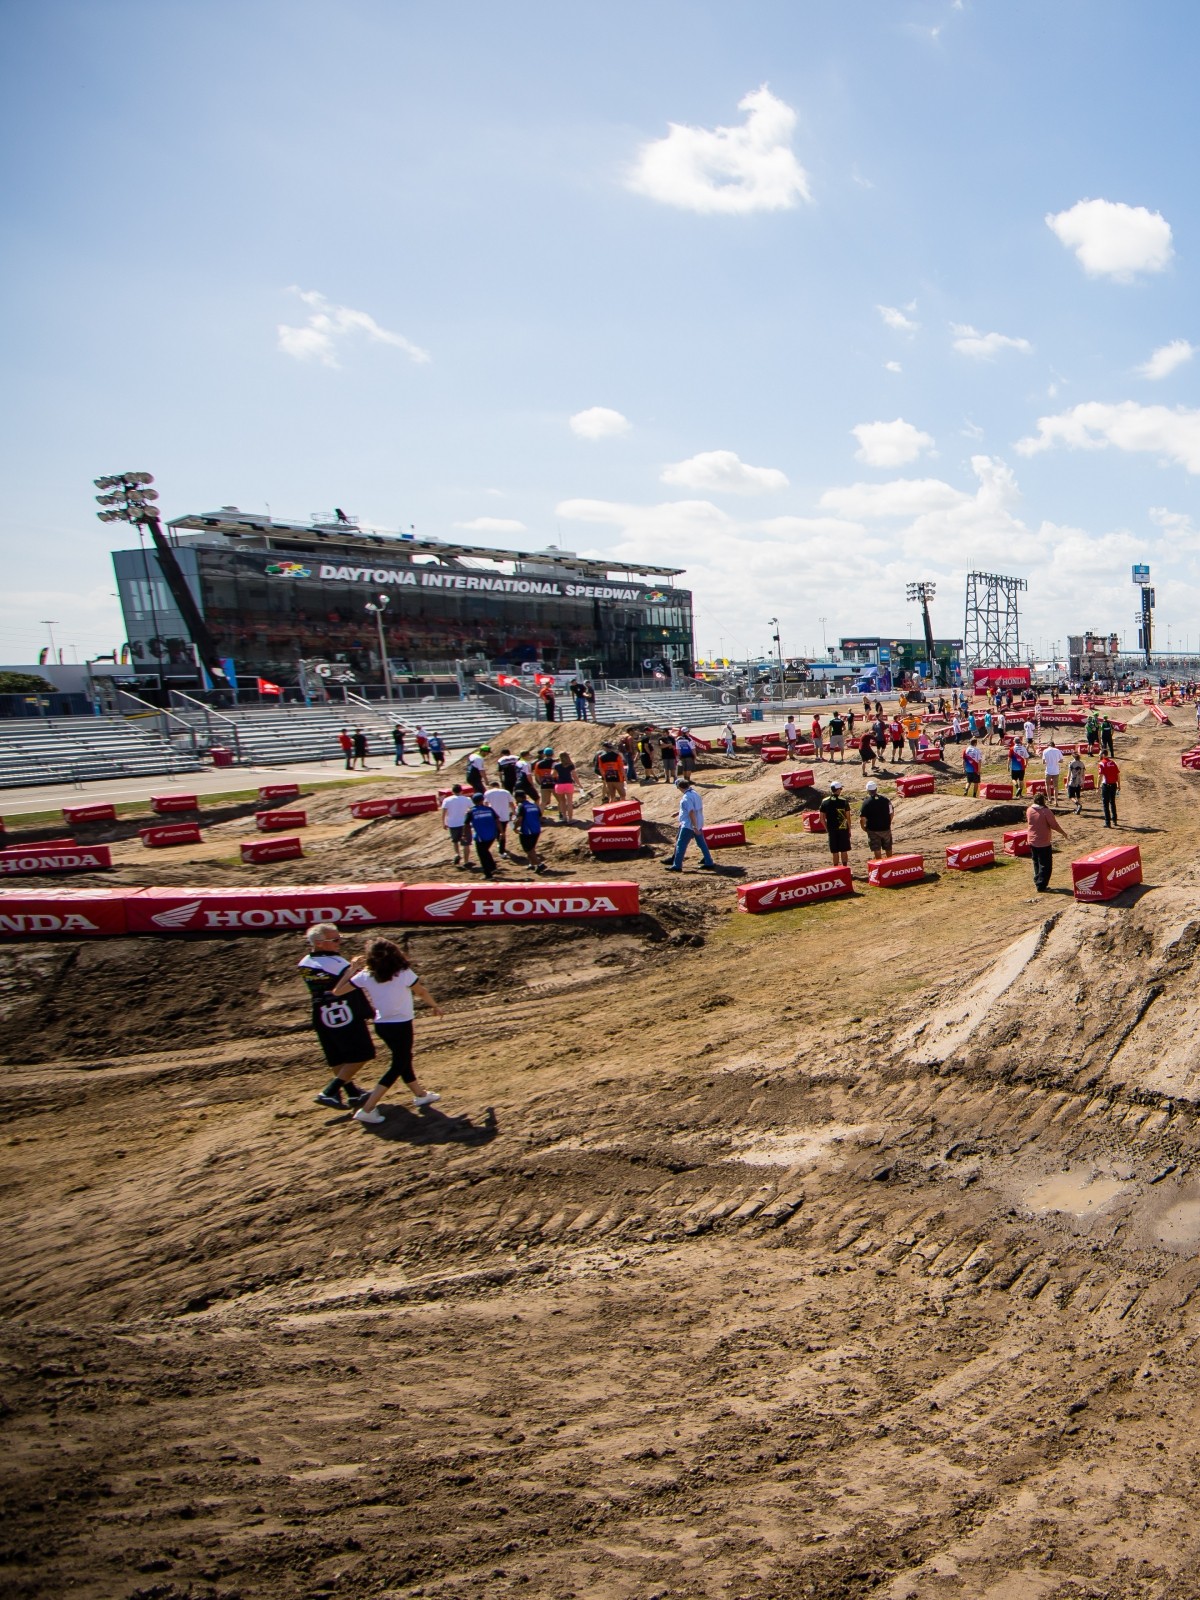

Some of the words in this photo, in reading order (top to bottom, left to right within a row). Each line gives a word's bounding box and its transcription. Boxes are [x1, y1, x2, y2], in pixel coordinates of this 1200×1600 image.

[319, 564, 417, 586] DAYTONA
[421, 573, 562, 596] INTERNATIONAL
[565, 584, 641, 601] SPEEDWAY
[315, 663, 332, 678] G
[1002, 677, 1027, 686] HONDA
[912, 782, 933, 790] HONDA
[615, 808, 641, 820] HONDA
[714, 831, 742, 839] HONDA
[0, 854, 101, 872] HONDA
[968, 849, 994, 861] HONDA
[892, 866, 923, 877] HONDA
[1115, 861, 1141, 878] HONDA
[779, 878, 847, 902] HONDA
[472, 896, 619, 916] HONDA
[0, 913, 100, 931] NDA
[203, 904, 377, 927] HONDA
